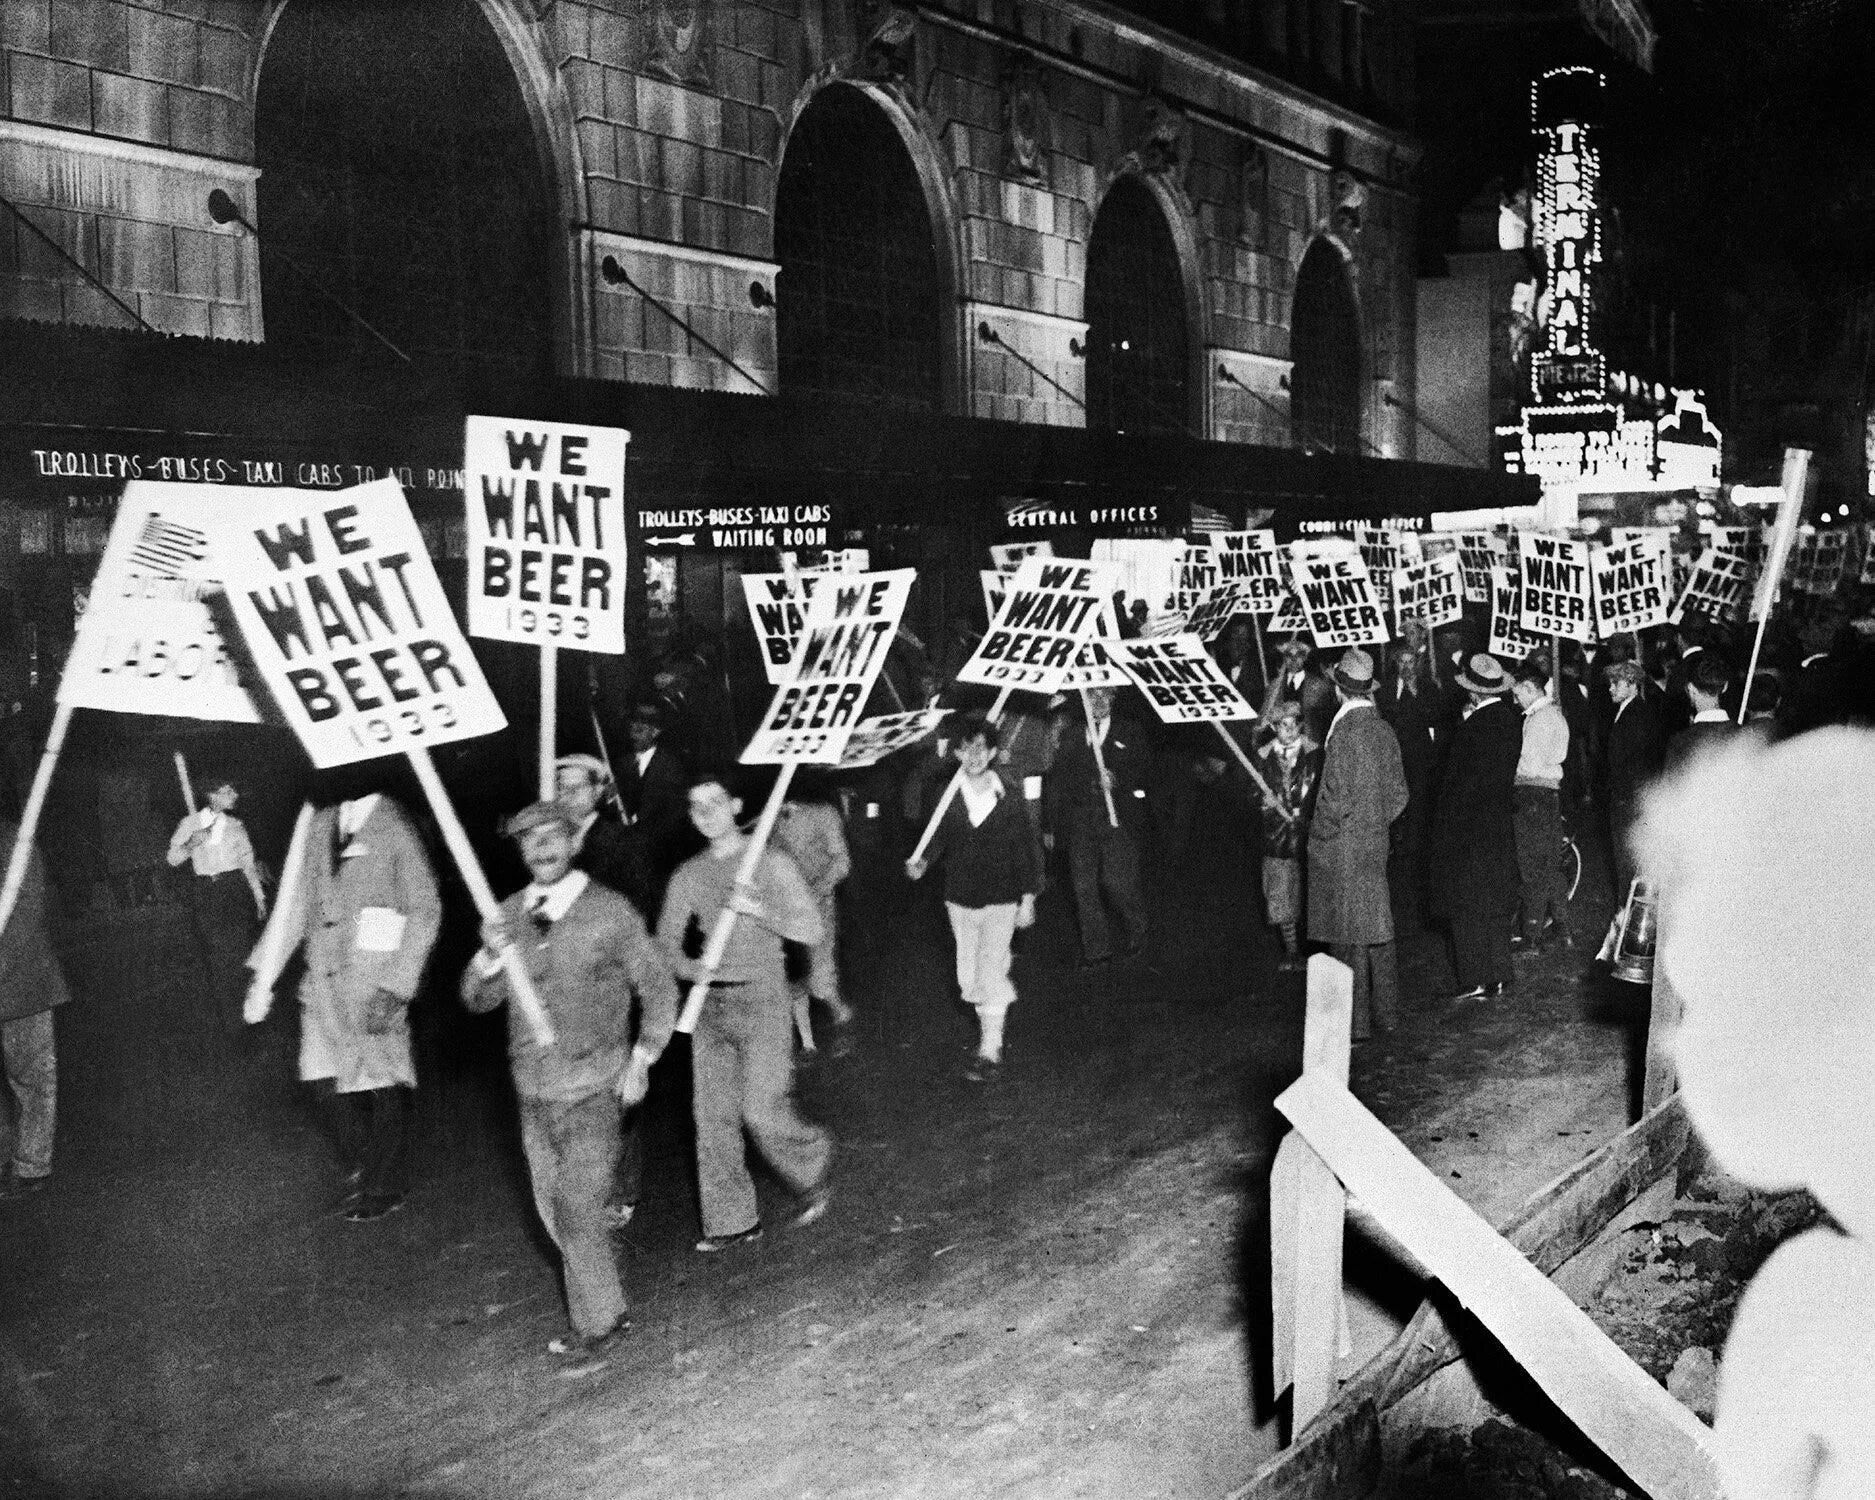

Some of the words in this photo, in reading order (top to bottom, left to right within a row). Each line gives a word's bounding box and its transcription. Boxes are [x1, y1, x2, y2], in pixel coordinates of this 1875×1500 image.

[1553, 123, 1588, 356] TERMINAL
[505, 430, 589, 476] WE
[299, 463, 342, 486] CABS
[481, 474, 611, 550] WANT
[794, 504, 831, 523] CABS
[1090, 506, 1158, 524] OFFICES
[253, 504, 374, 572] WE
[712, 528, 775, 547] WAITING
[783, 527, 827, 546] ROOM
[1225, 534, 1261, 551] WE
[1364, 531, 1390, 546] WE
[1461, 535, 1488, 548] WE
[1534, 538, 1574, 561] WE
[1218, 551, 1273, 578] WANT
[1607, 543, 1645, 566] WE
[483, 546, 611, 610] BEER
[1039, 565, 1091, 591] WE
[1171, 565, 1216, 589] ANT
[1308, 562, 1351, 580] WE
[1407, 562, 1444, 583] WE
[1525, 556, 1584, 594] WANT
[1598, 558, 1656, 595] WANT
[834, 581, 890, 619] WE
[1303, 578, 1370, 610] WANT
[1399, 573, 1454, 606] WANT
[247, 552, 425, 661] WANT
[1003, 591, 1099, 634] WANT
[1526, 587, 1584, 621] BEER
[1600, 587, 1661, 620] BEER
[507, 607, 590, 640] 1933
[1311, 606, 1380, 633] BEER
[1535, 615, 1575, 634] 1933
[1614, 612, 1653, 629] 1933
[797, 621, 892, 680] WANT
[980, 631, 1075, 668] BEER
[1126, 642, 1185, 660] WE
[1331, 631, 1374, 644] 1933
[1501, 641, 1526, 656] 193
[285, 640, 466, 722] BEER
[983, 664, 1045, 684] 1933
[1126, 659, 1216, 684] WANT
[769, 683, 862, 730] BEER
[1147, 684, 1239, 707] BEER
[349, 703, 457, 748] 1933
